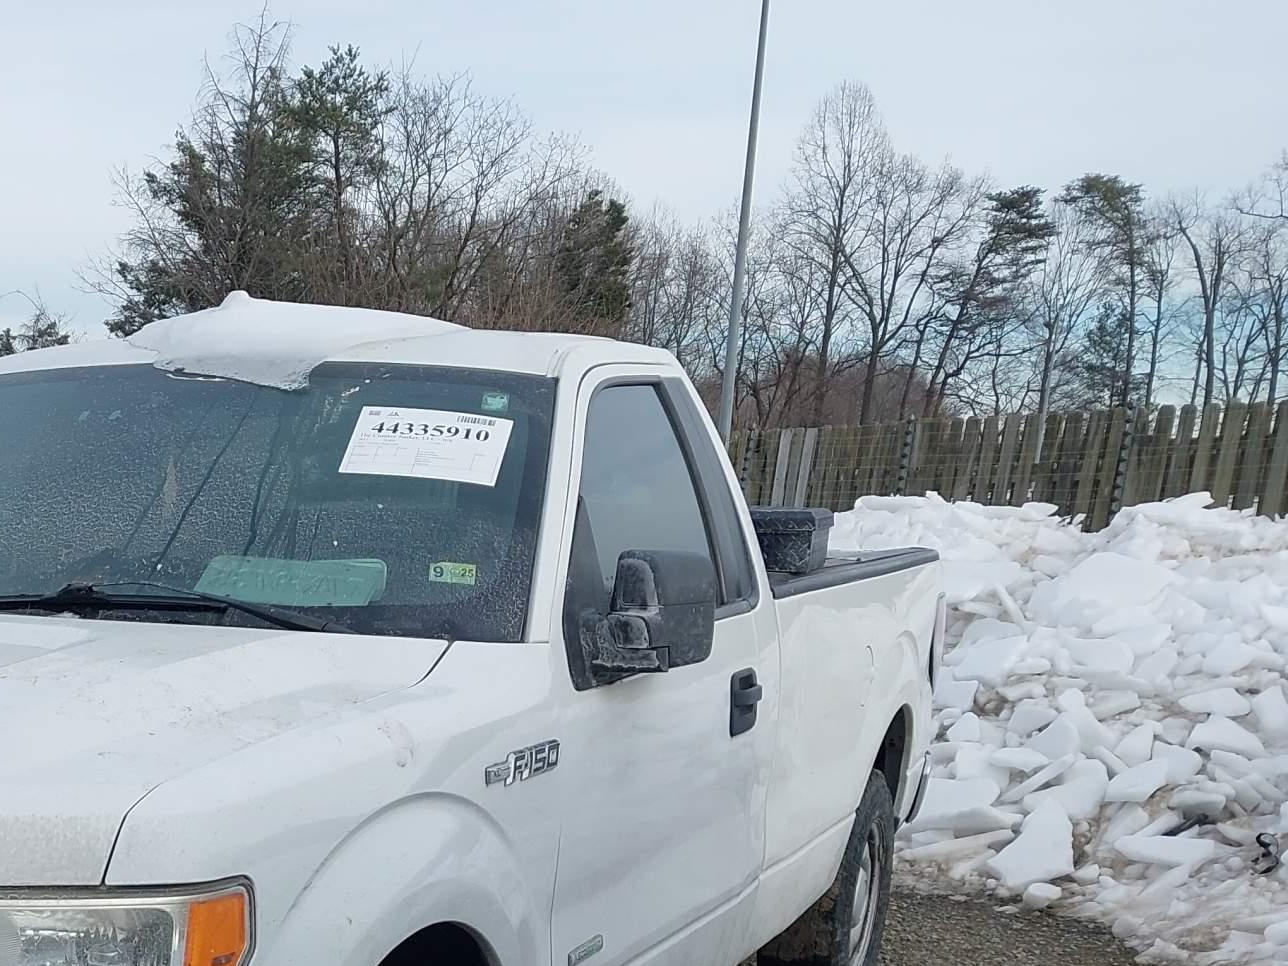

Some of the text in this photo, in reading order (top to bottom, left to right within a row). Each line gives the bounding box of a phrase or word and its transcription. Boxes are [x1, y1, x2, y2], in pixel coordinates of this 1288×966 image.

[371, 421, 490, 442] 44335910
[433, 566, 444, 577] 9
[460, 568, 474, 578] 25
